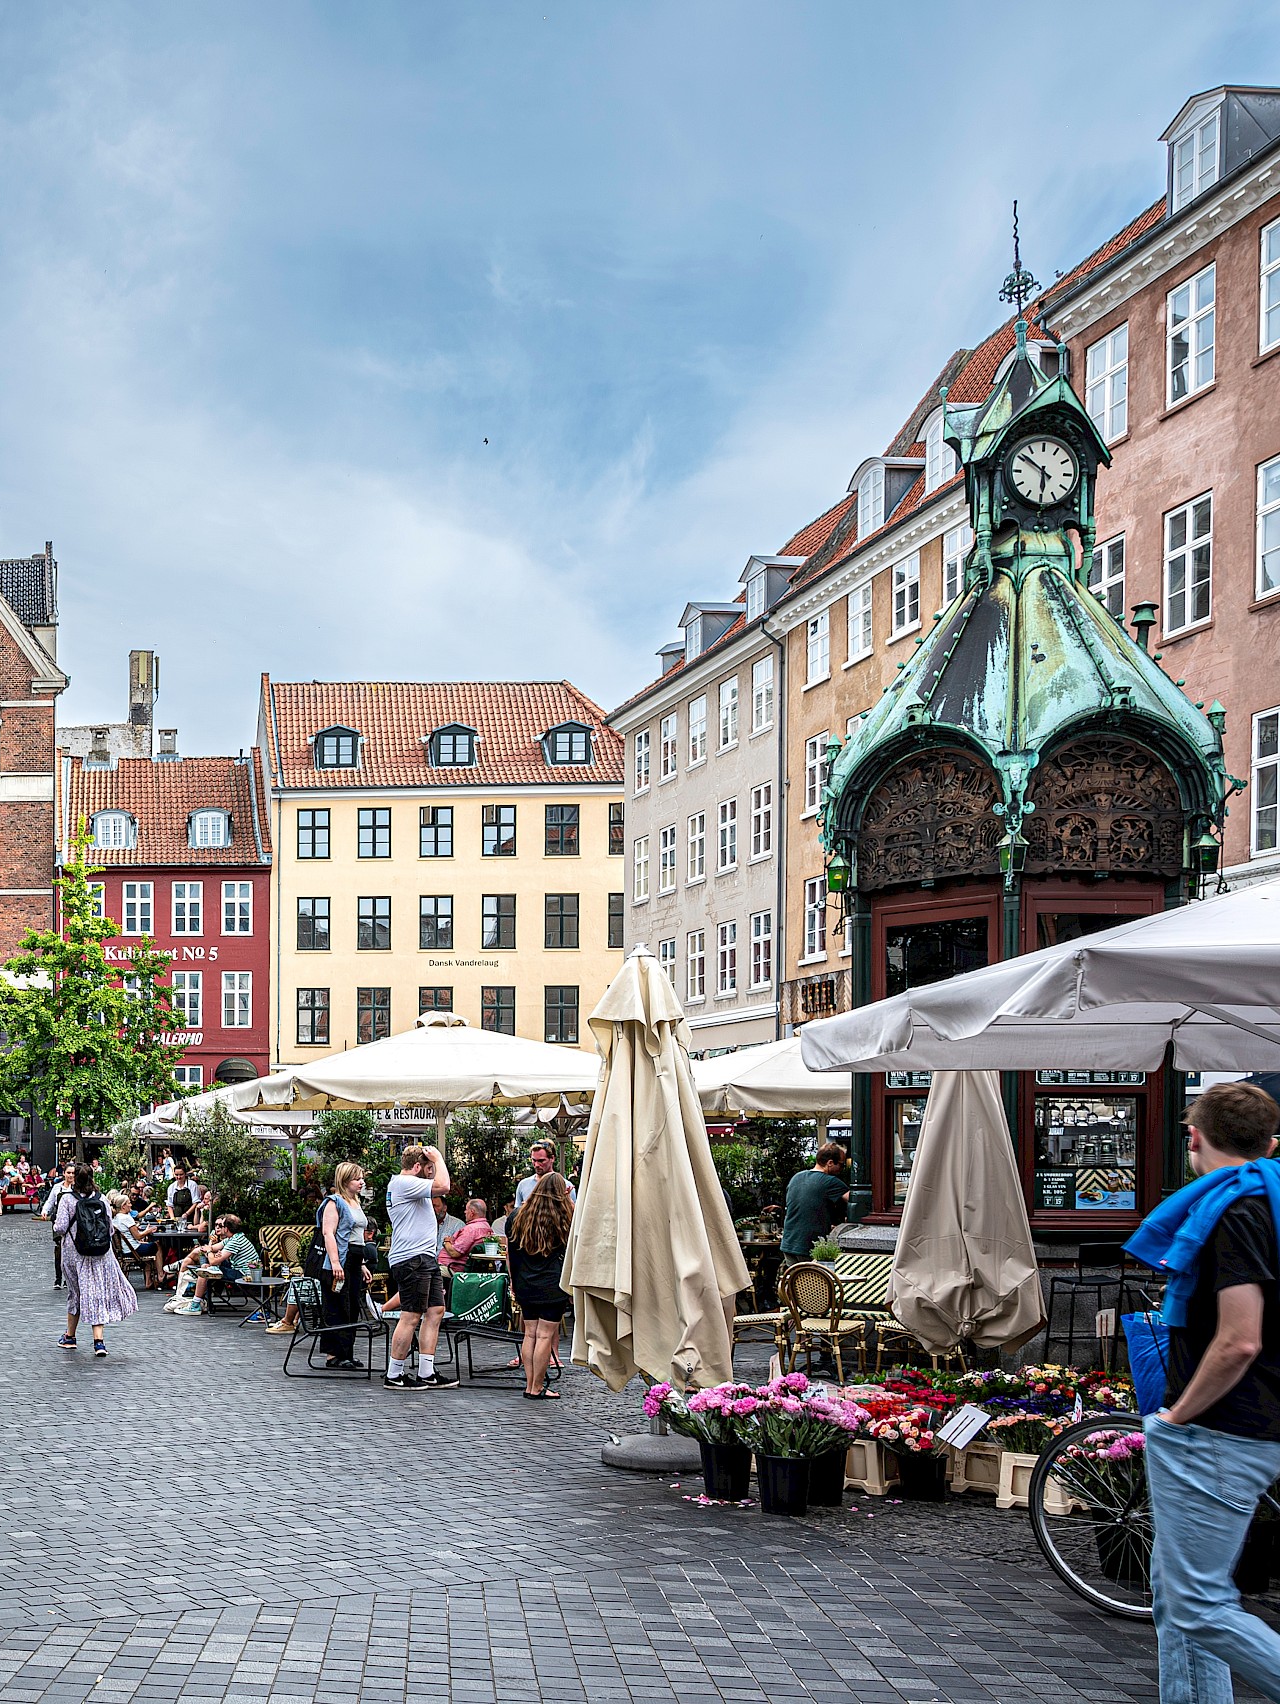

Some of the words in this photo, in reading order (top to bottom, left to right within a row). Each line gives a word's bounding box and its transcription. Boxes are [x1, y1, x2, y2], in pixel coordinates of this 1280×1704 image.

[208, 946, 218, 961] 5
[428, 959, 453, 967] Dansk
[455, 959, 499, 968] Vandrelaug
[385, 1109, 391, 1120] &
